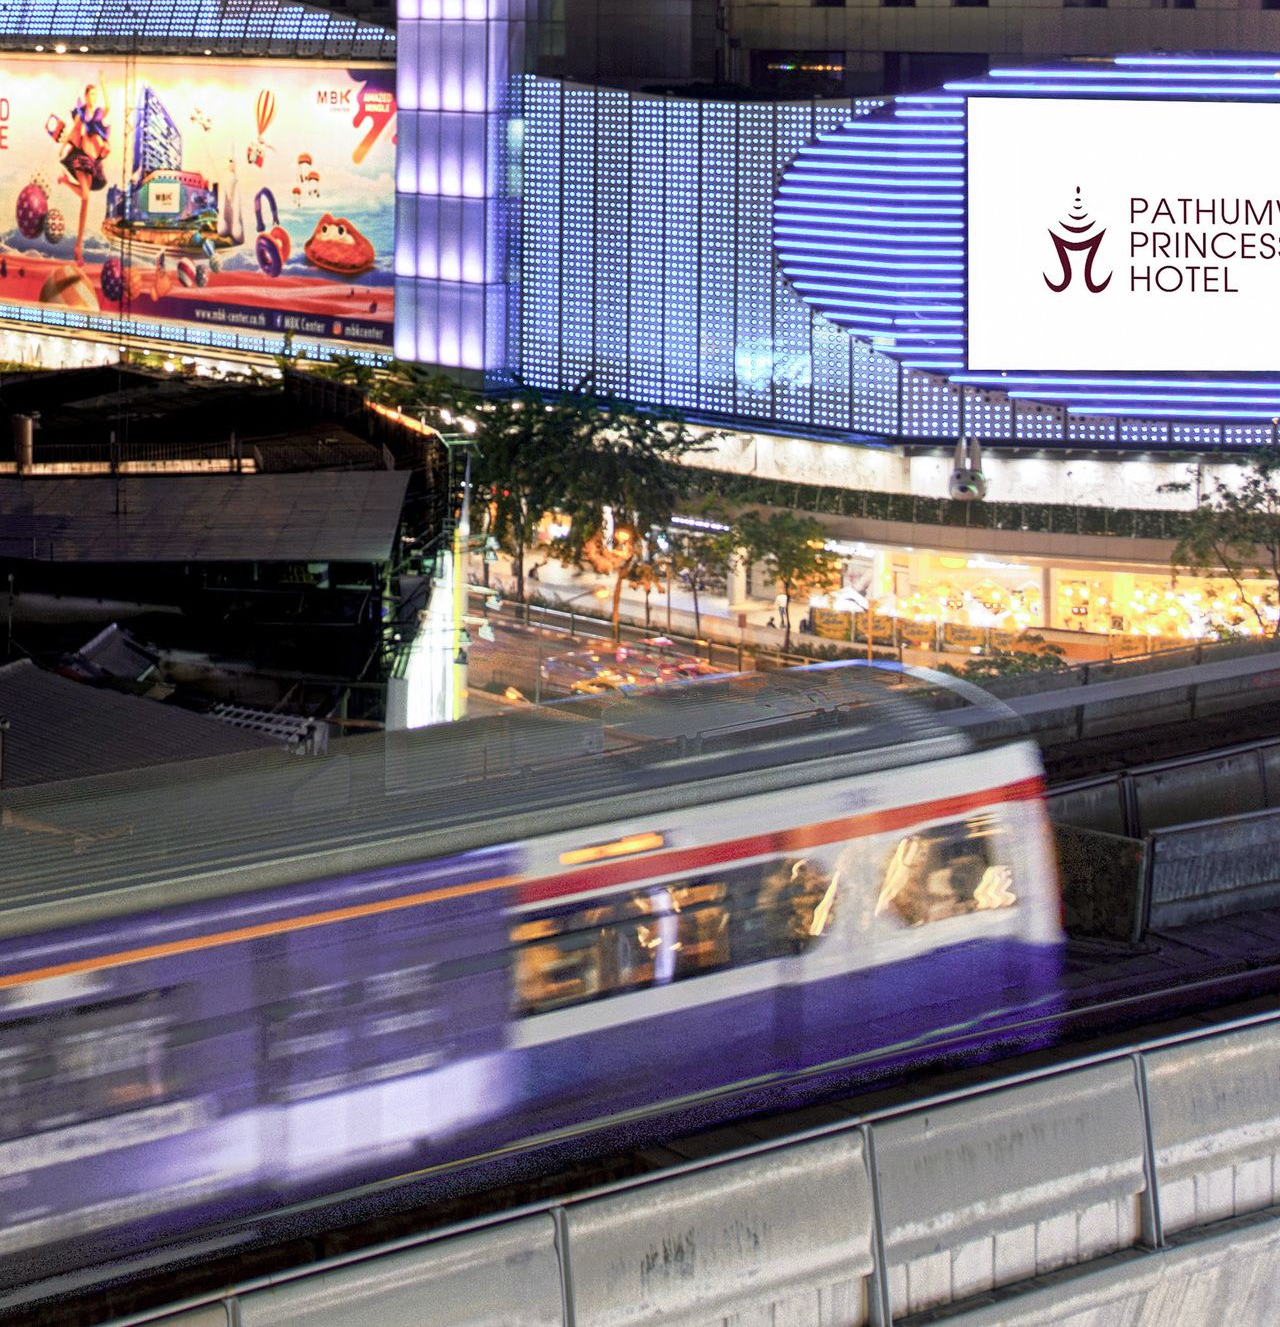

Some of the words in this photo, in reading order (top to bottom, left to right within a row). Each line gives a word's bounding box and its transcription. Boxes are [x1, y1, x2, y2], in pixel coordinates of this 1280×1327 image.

[317, 89, 351, 104] MBK
[1130, 265, 1239, 293] HOTEL
[301, 318, 325, 333] Center
